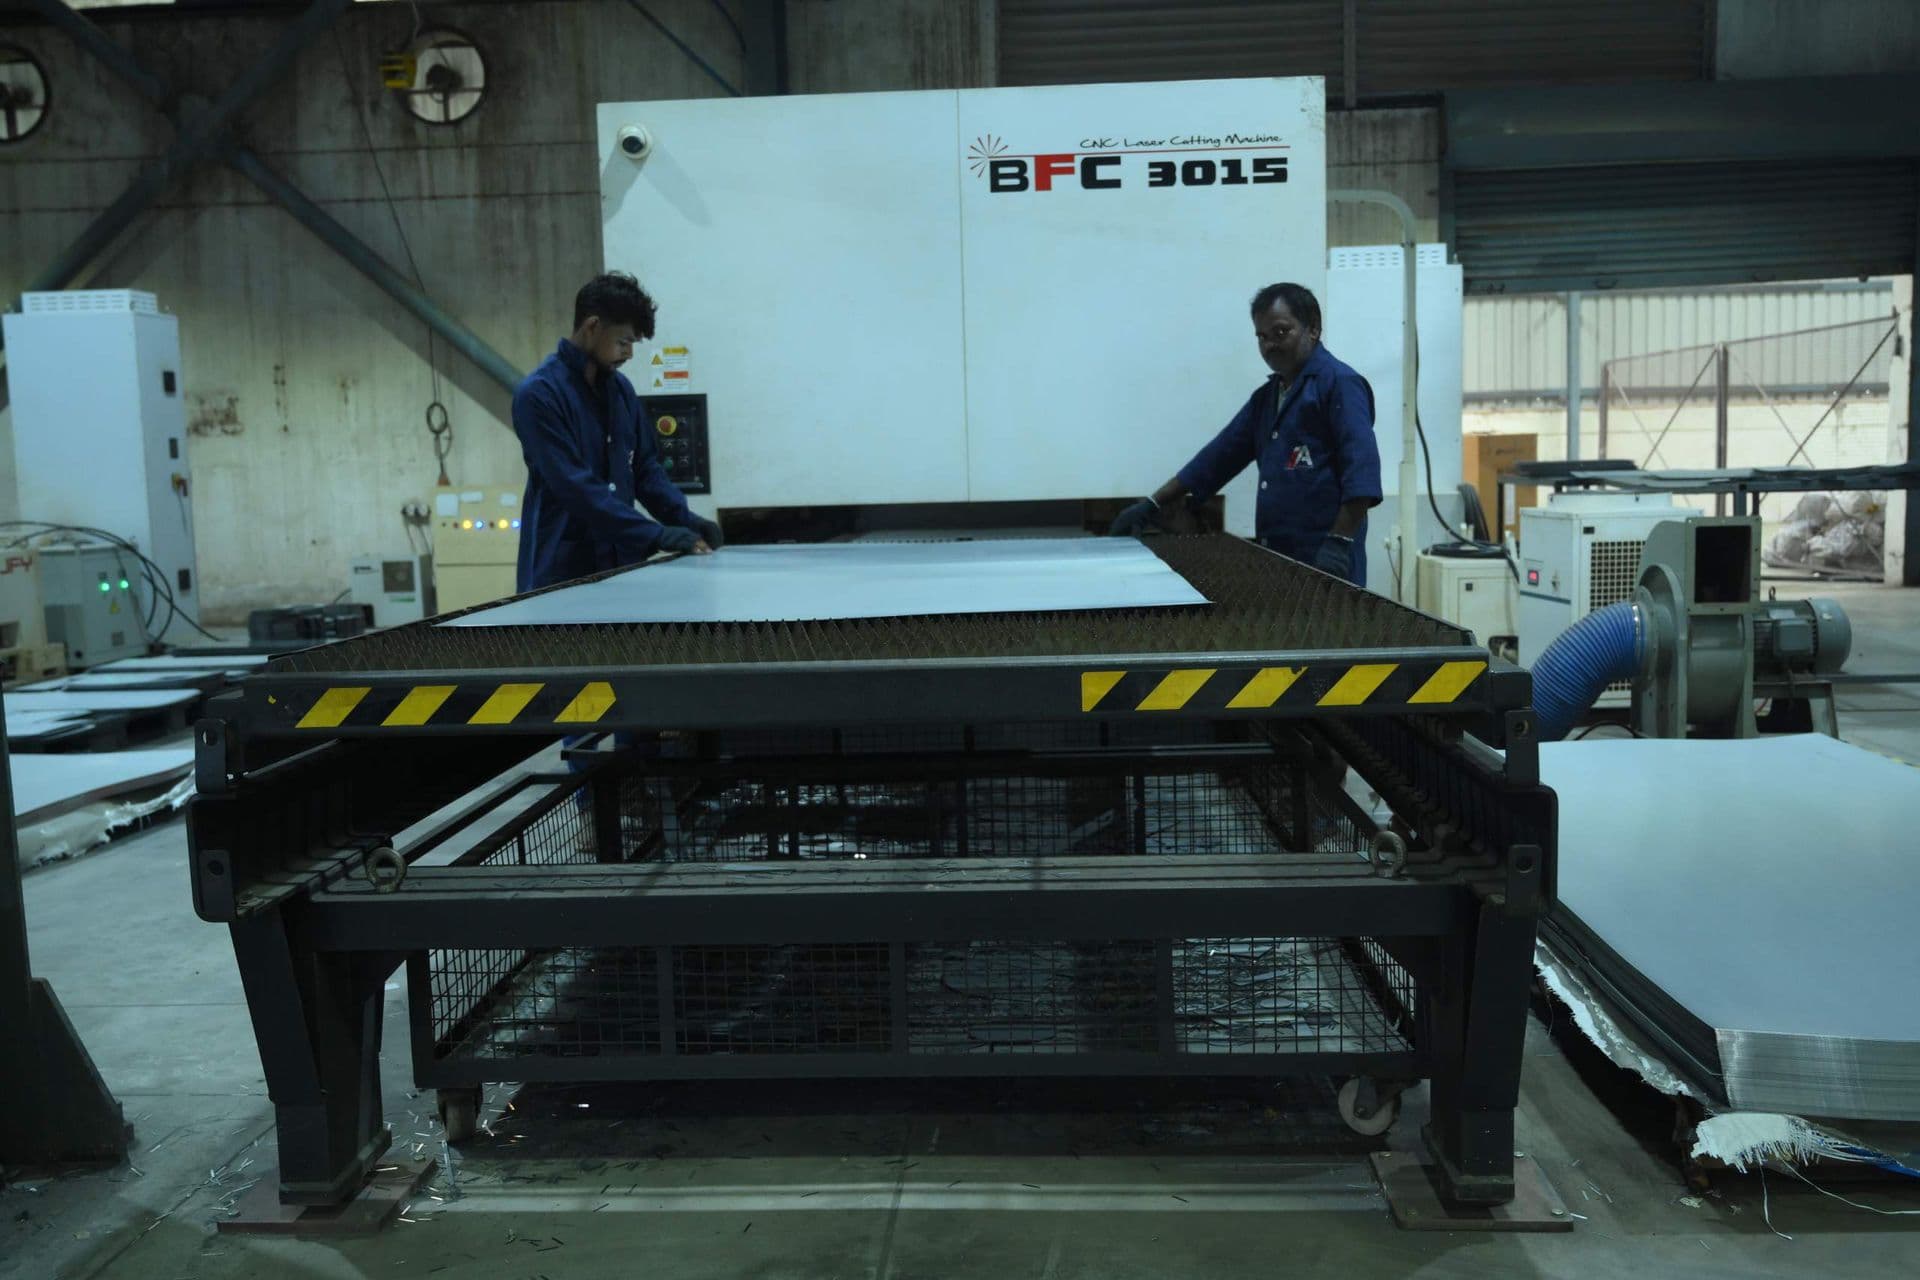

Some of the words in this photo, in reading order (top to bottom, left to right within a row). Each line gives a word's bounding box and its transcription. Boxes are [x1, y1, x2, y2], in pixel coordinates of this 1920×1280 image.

[1080, 138, 1118, 149] CNC
[1124, 138, 1165, 147] Laser
[1225, 133, 1283, 144] Machine
[990, 154, 1122, 193] BFC
[1148, 157, 1288, 188] 3015
